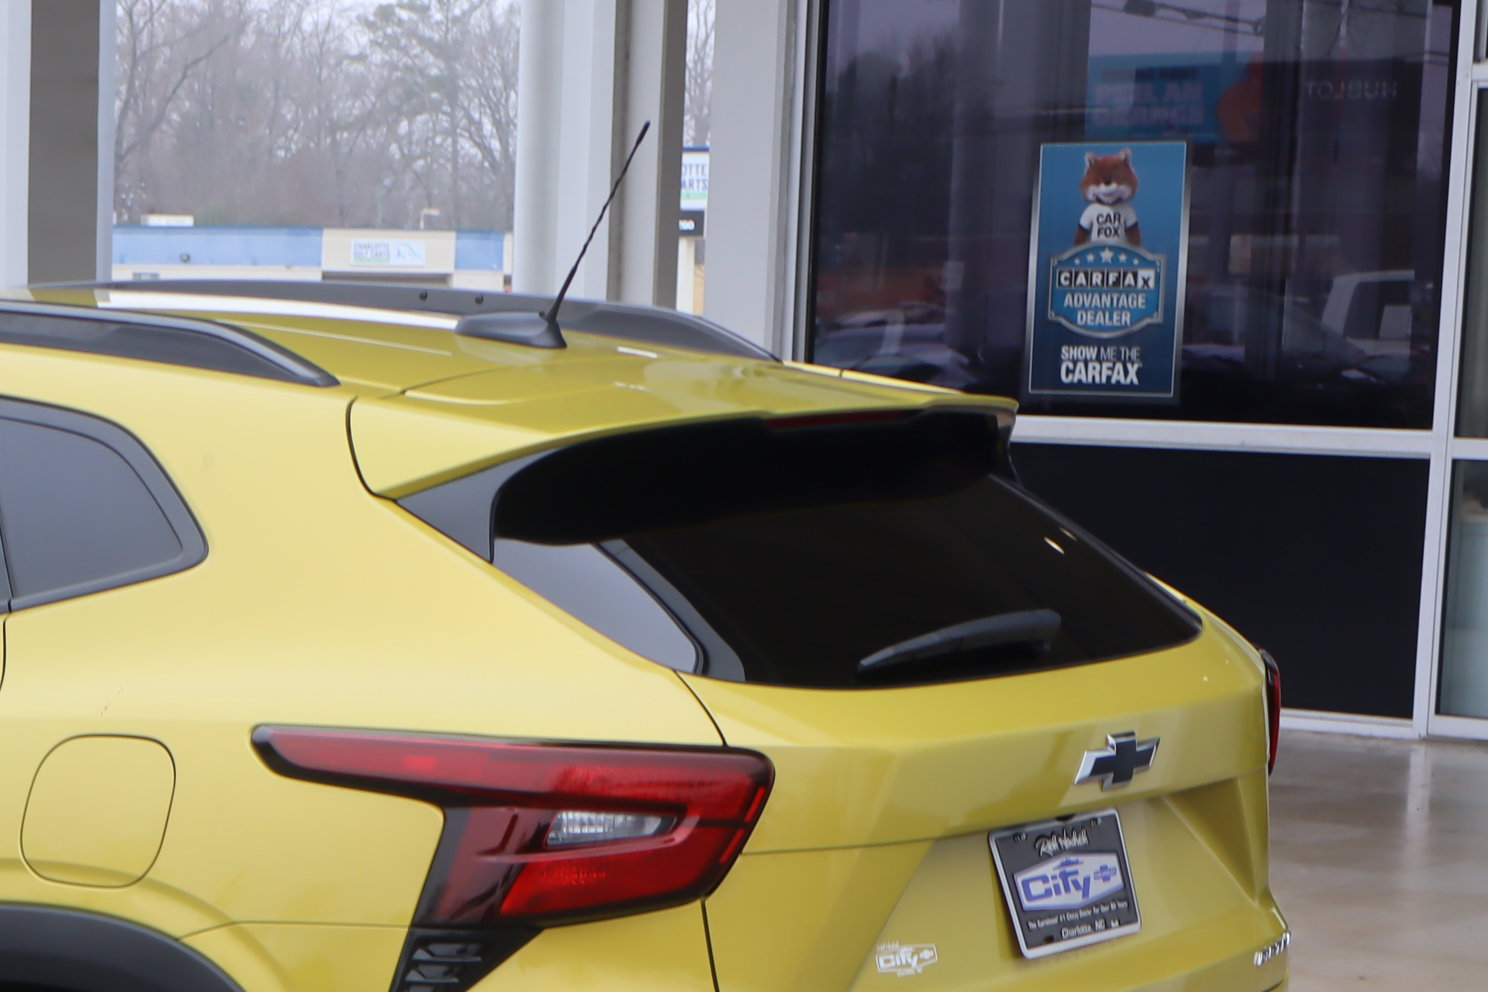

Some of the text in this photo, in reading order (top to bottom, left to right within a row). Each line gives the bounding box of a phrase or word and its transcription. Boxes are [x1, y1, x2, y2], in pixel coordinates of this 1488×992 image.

[1096, 213, 1121, 226] CAR
[1097, 226, 1121, 238] FOX
[1059, 270, 1154, 289] CARFAX
[1064, 292, 1147, 309] ADVANTAGE
[1076, 309, 1132, 327] DEALER
[1061, 345, 1141, 362] SHOW ME THE
[1060, 361, 1140, 385] CARFAX
[1021, 868, 1092, 902] City
